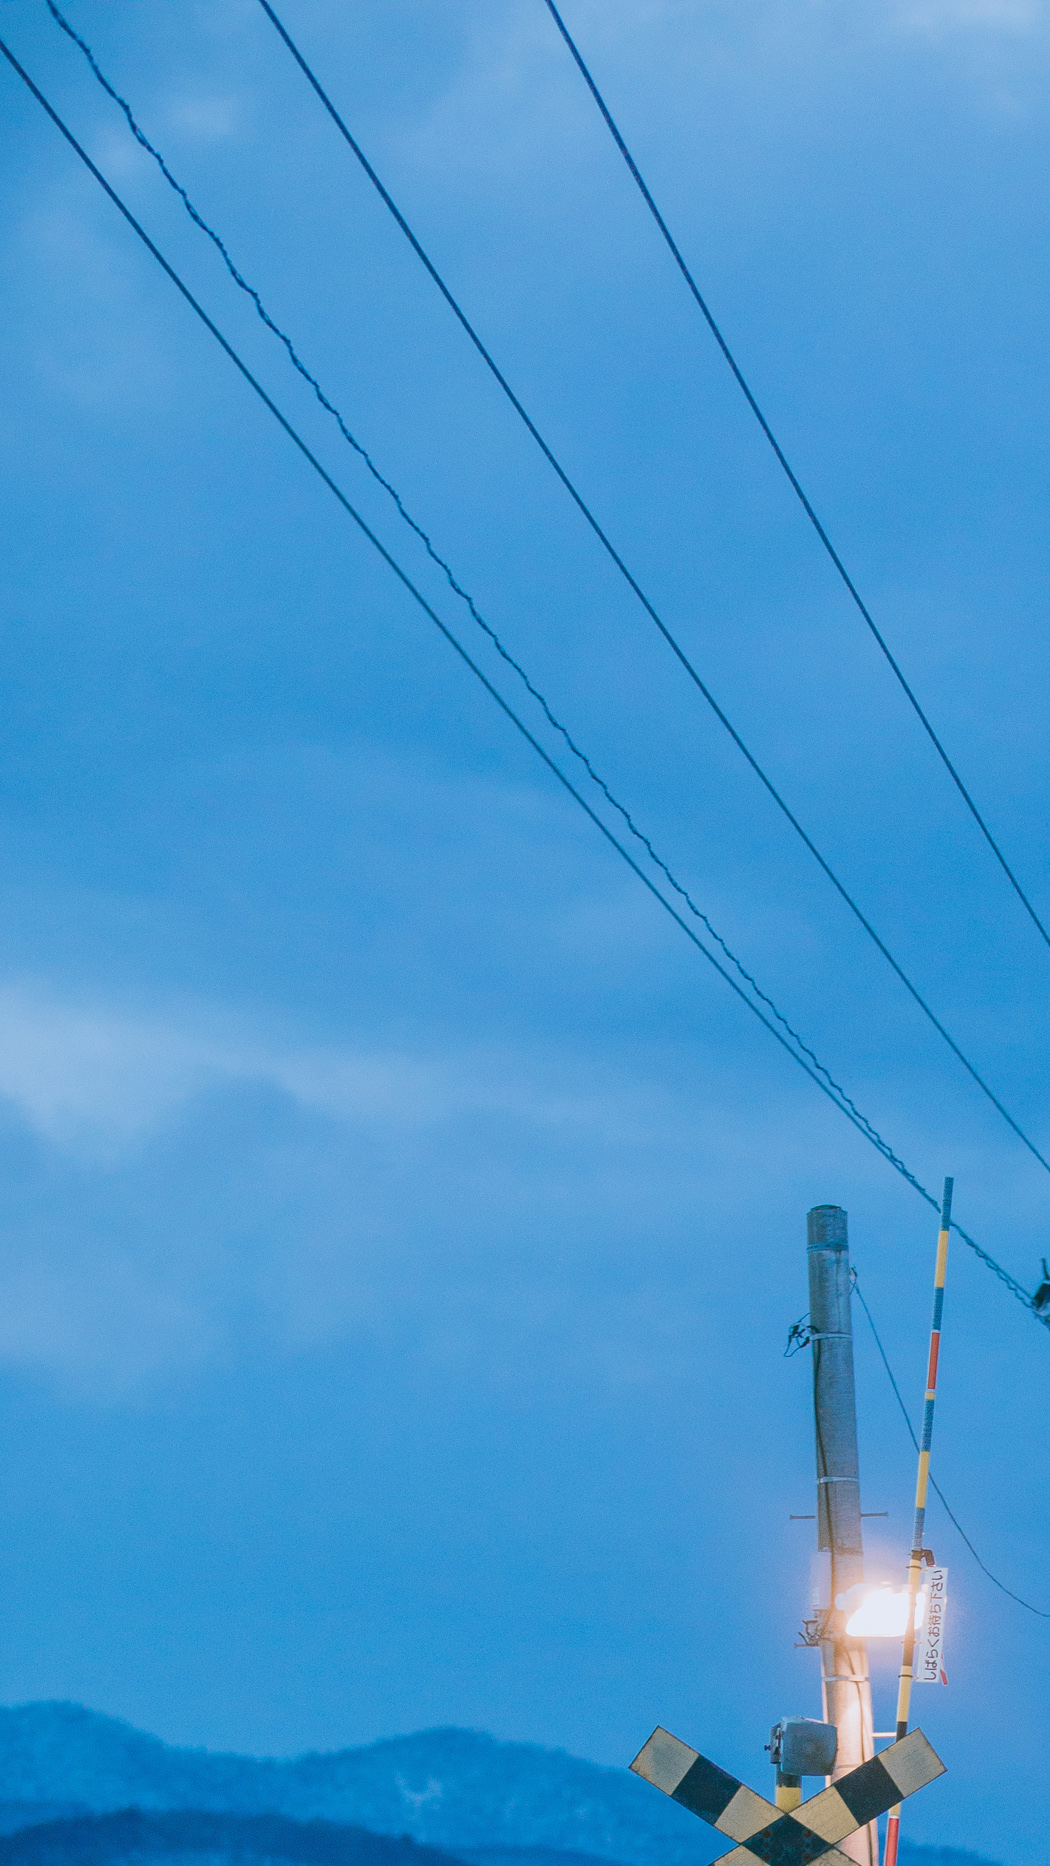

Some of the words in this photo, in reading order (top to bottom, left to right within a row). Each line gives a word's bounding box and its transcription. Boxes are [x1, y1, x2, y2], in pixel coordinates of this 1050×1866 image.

[924, 1569, 944, 1681] しばらくお待ち下さい
